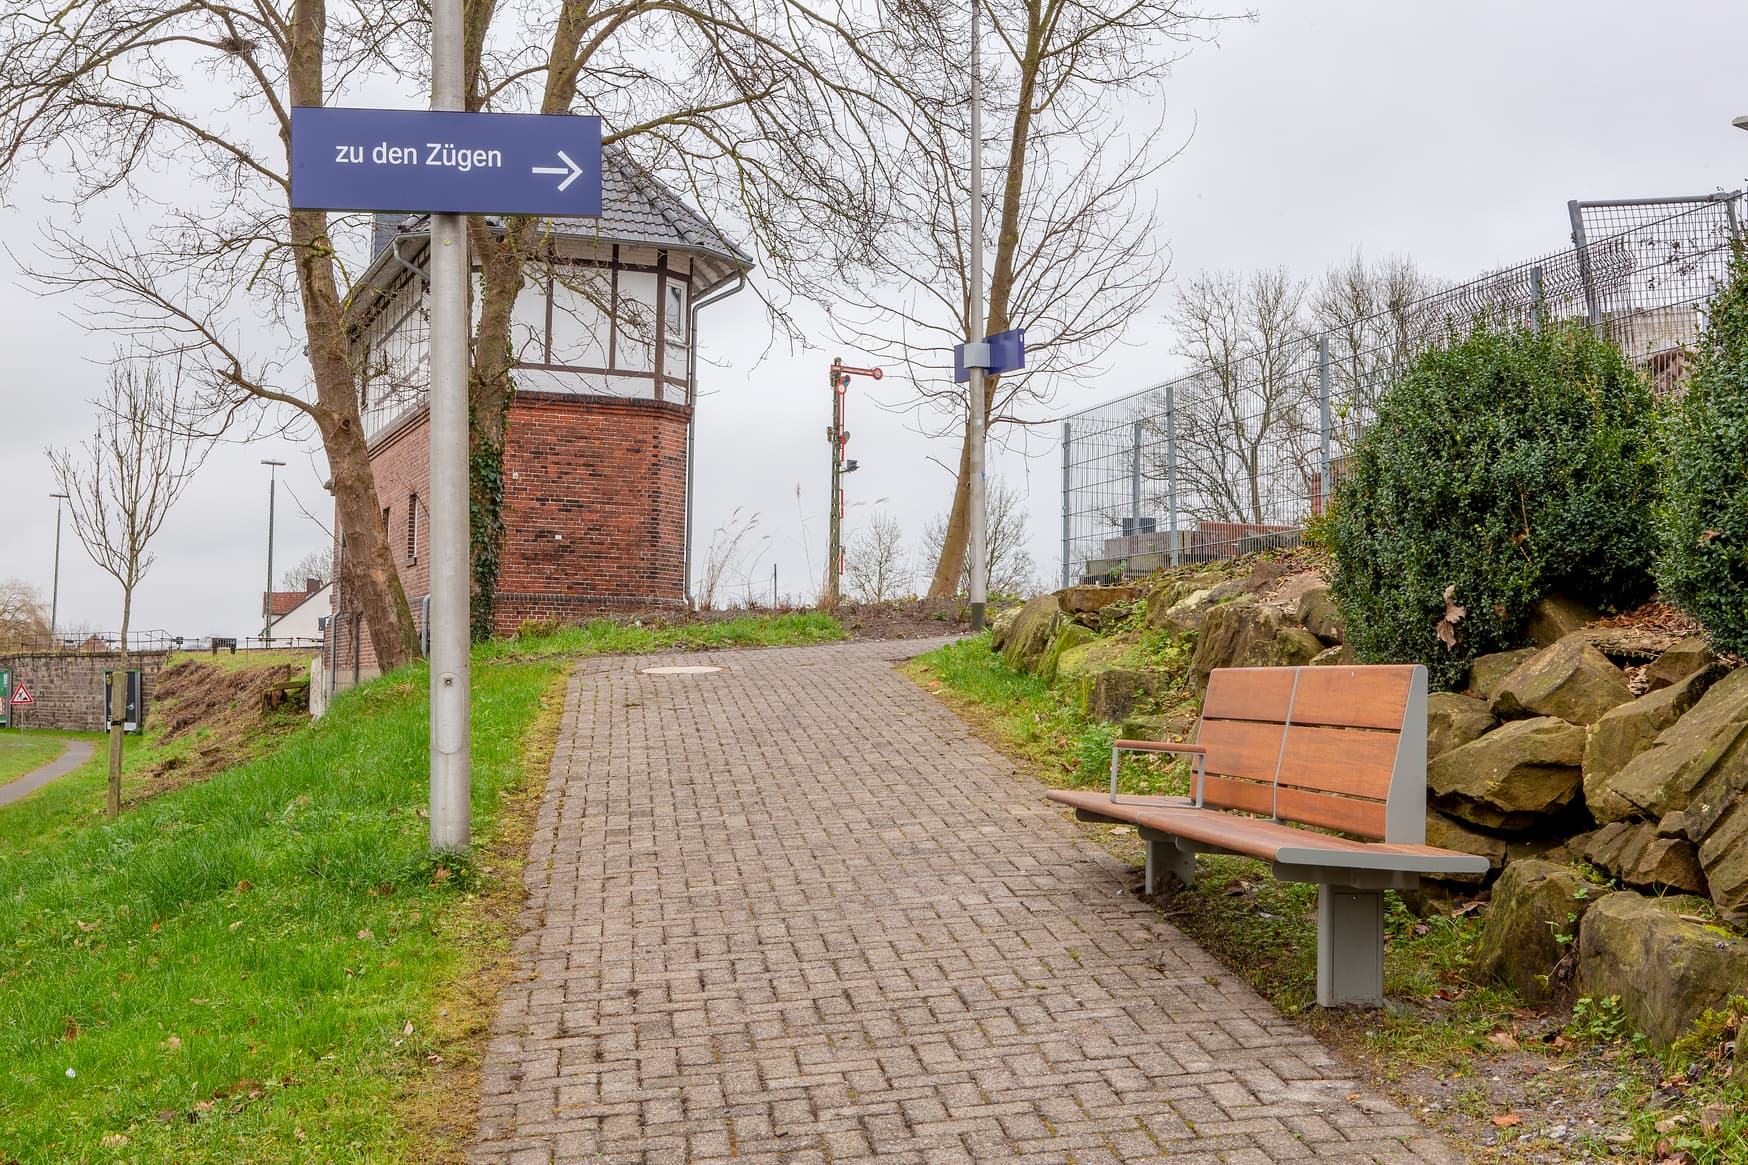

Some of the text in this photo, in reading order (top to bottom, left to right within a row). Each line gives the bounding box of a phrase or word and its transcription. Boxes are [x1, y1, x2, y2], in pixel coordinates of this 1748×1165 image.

[335, 141, 502, 172] zu den Zügen
